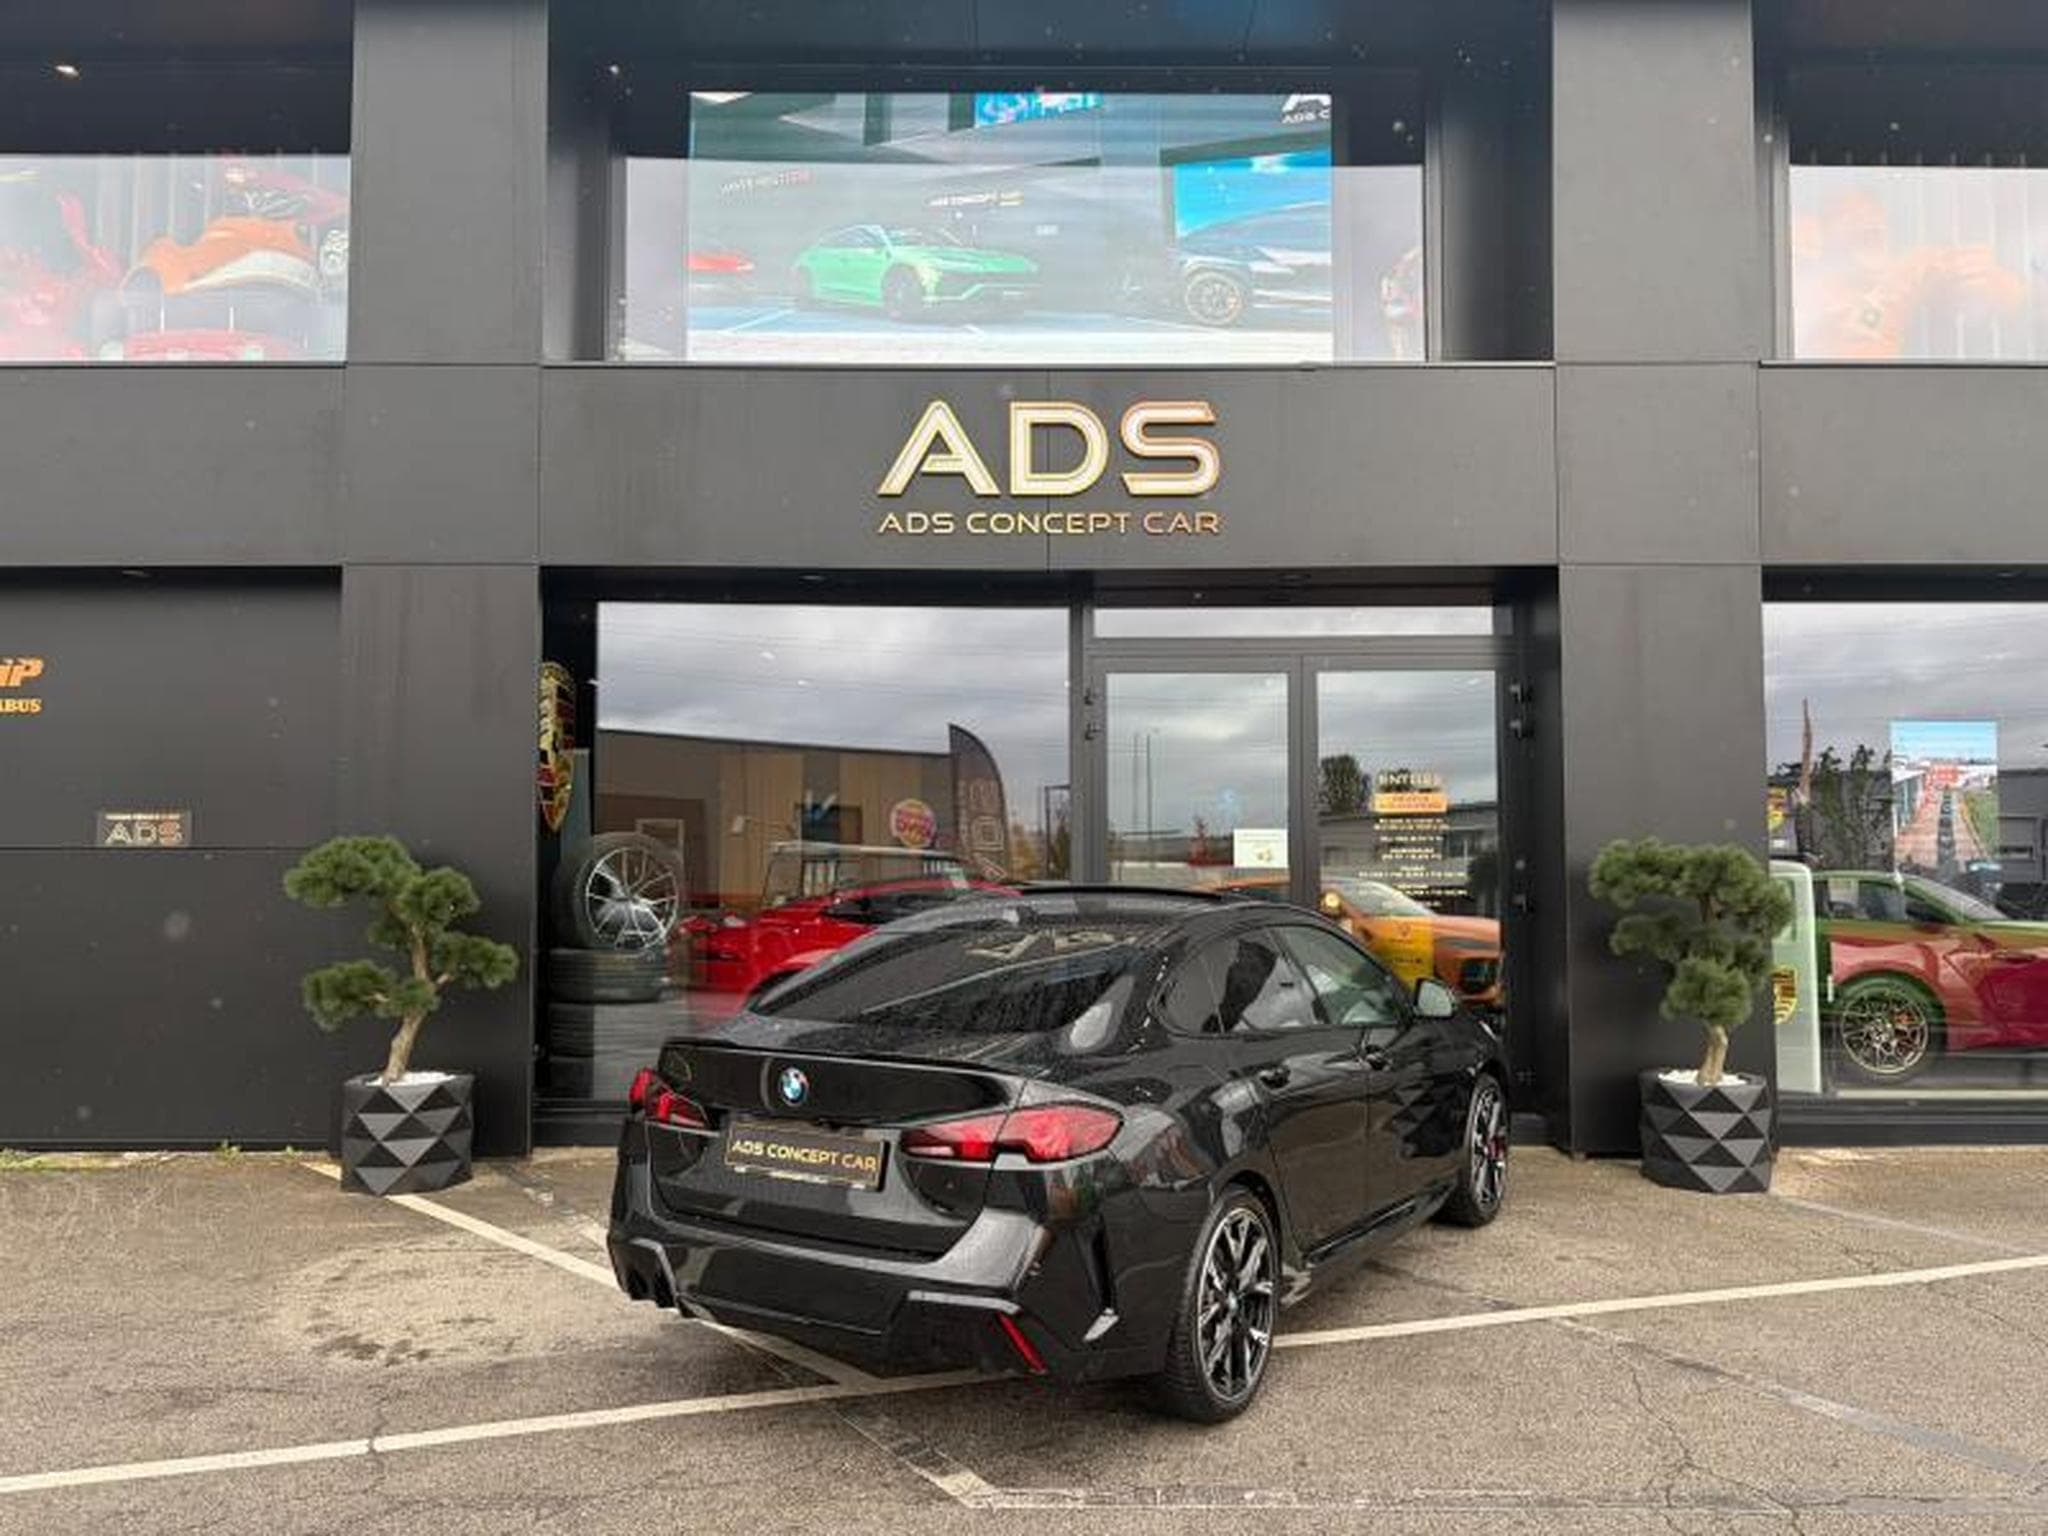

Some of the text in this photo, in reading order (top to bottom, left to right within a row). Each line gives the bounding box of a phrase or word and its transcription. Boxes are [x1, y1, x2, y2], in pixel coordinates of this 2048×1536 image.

[877, 400, 1220, 496] ADS
[878, 512, 1221, 535] ADS CONCEPT CAR
[104, 822, 183, 847] ADS
[732, 1139, 877, 1172] ADS CONCEPT CAR
